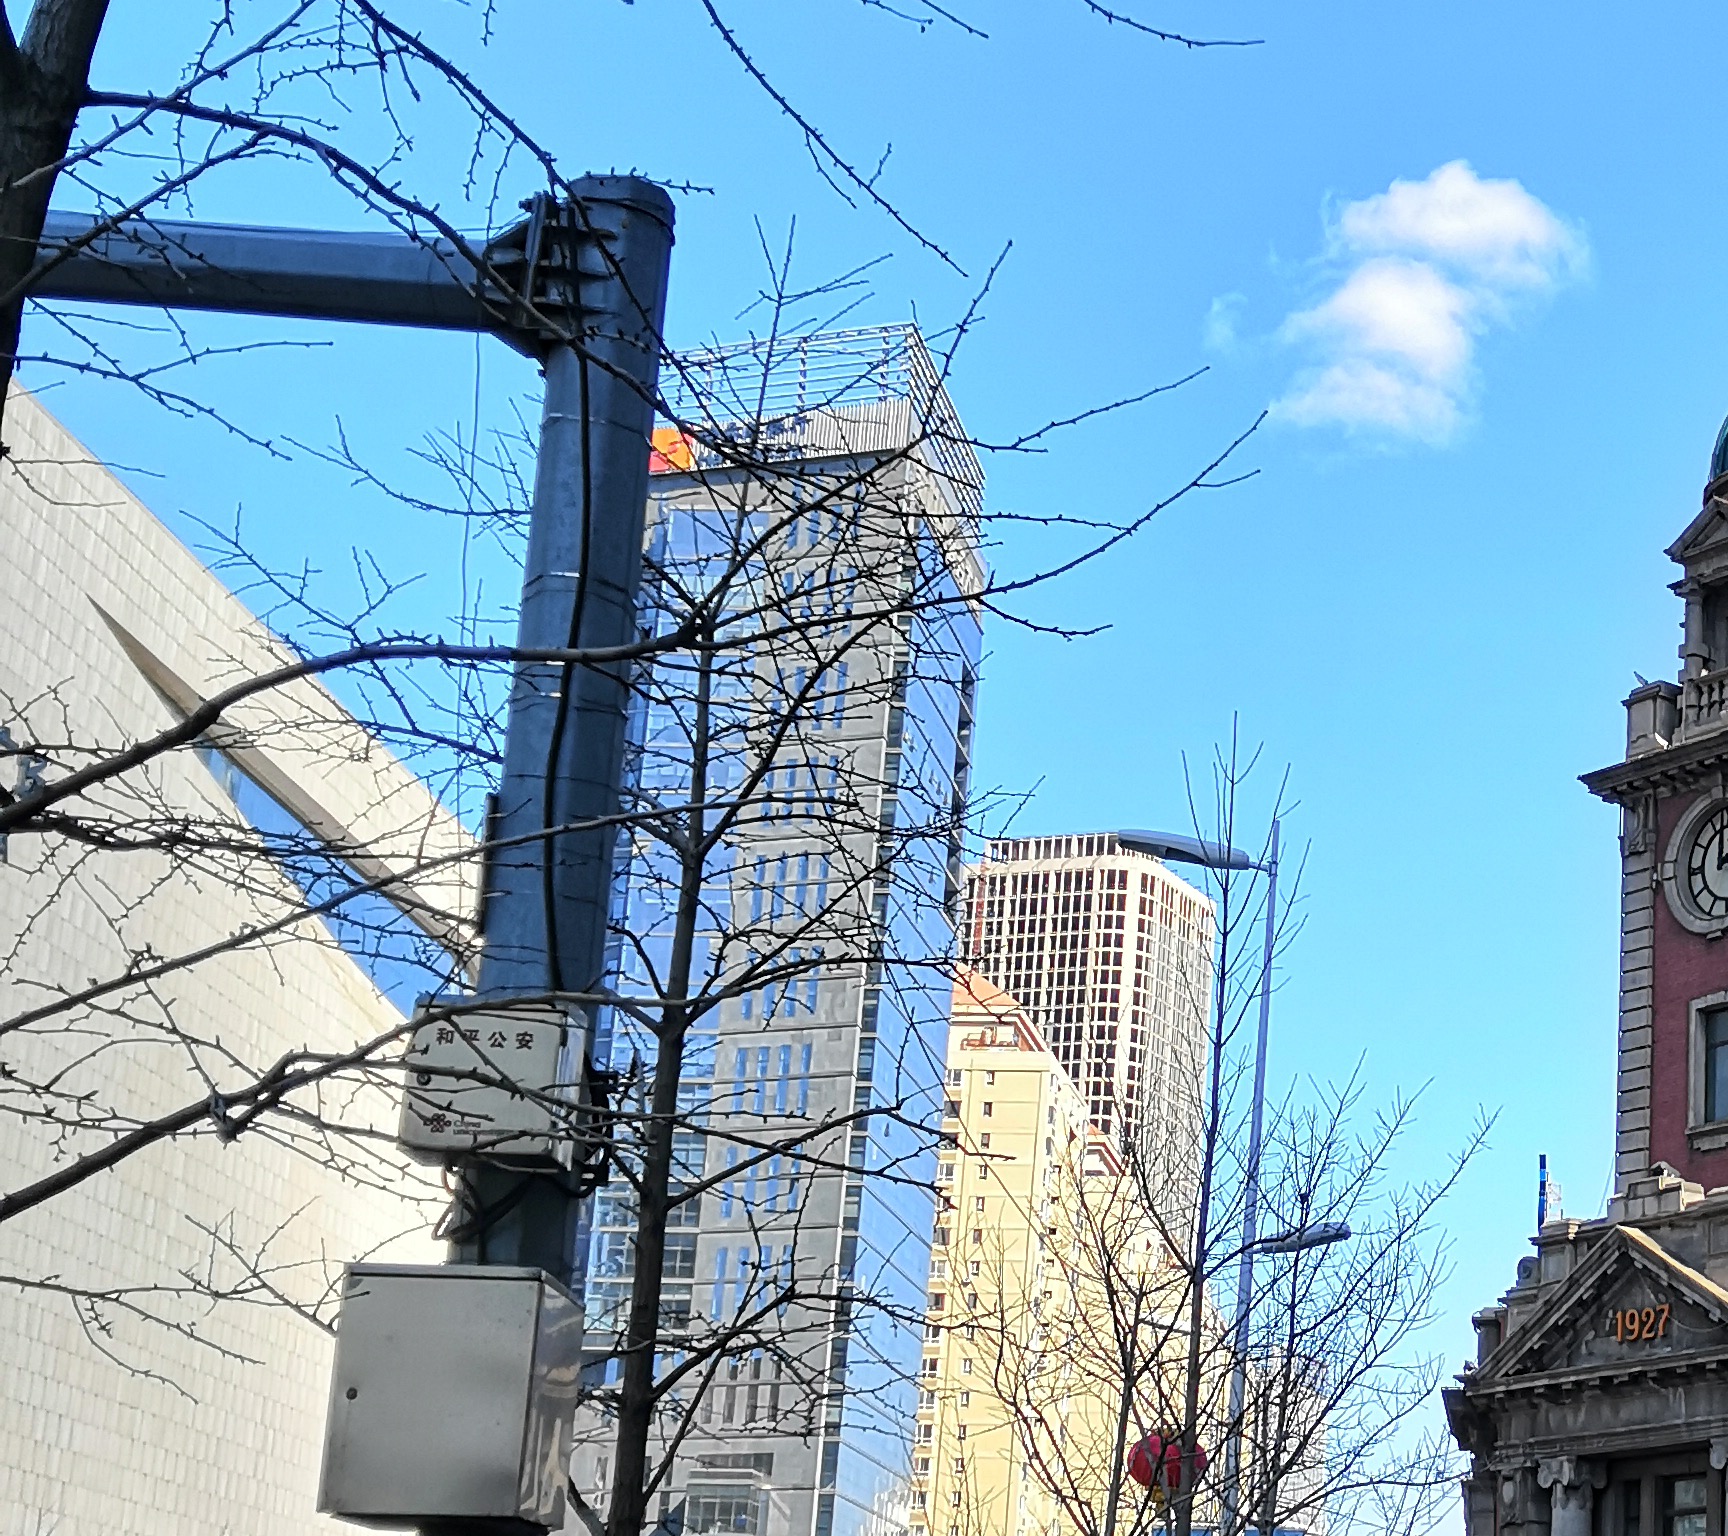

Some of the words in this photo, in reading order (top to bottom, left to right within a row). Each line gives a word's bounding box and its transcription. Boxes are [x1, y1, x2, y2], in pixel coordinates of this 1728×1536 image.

[436, 1027, 534, 1050] 和平公安
[1615, 1303, 1671, 1343] 1927
